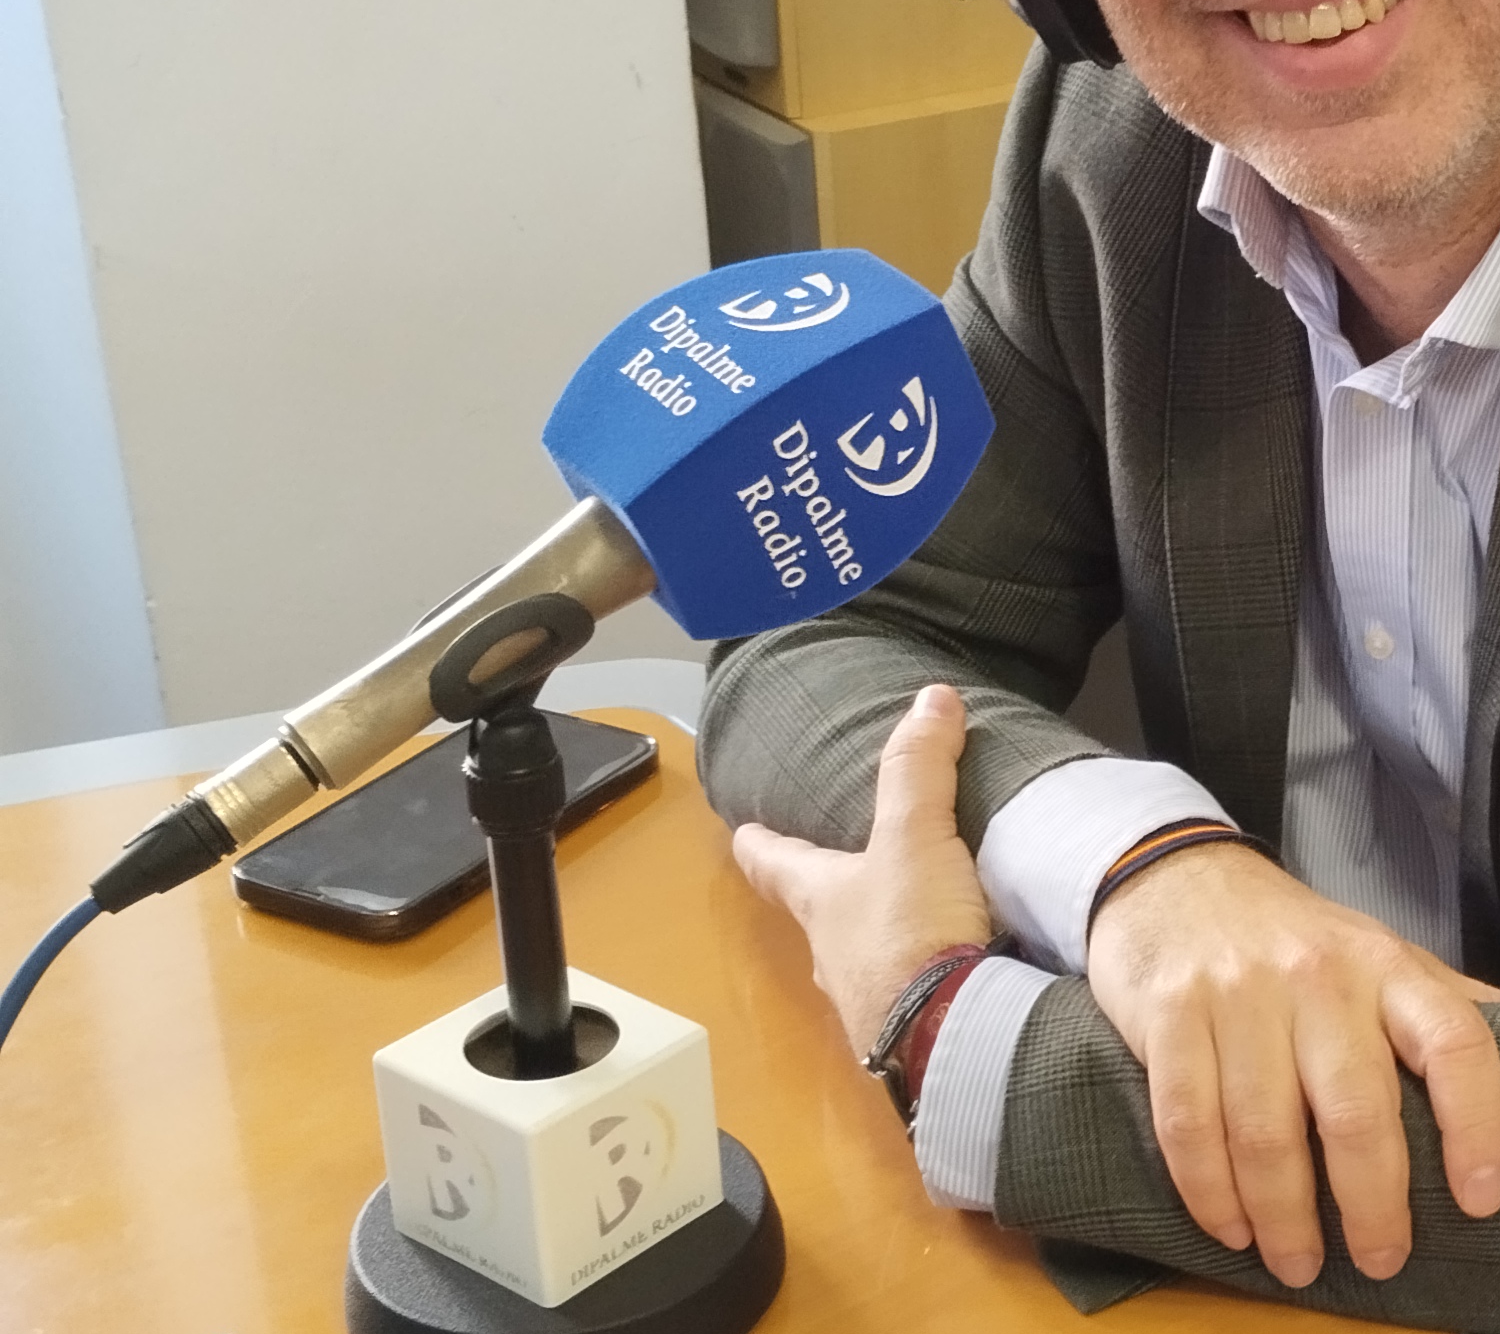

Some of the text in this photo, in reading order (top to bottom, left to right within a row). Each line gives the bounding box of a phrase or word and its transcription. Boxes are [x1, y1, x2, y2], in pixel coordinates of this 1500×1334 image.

[619, 348, 697, 417] Radio
[650, 305, 757, 395] Dipalme
[737, 475, 808, 589] Radio
[773, 420, 863, 586] Dipalme
[570, 1230, 649, 1286] DIPALME
[651, 1193, 706, 1235] RADIO
